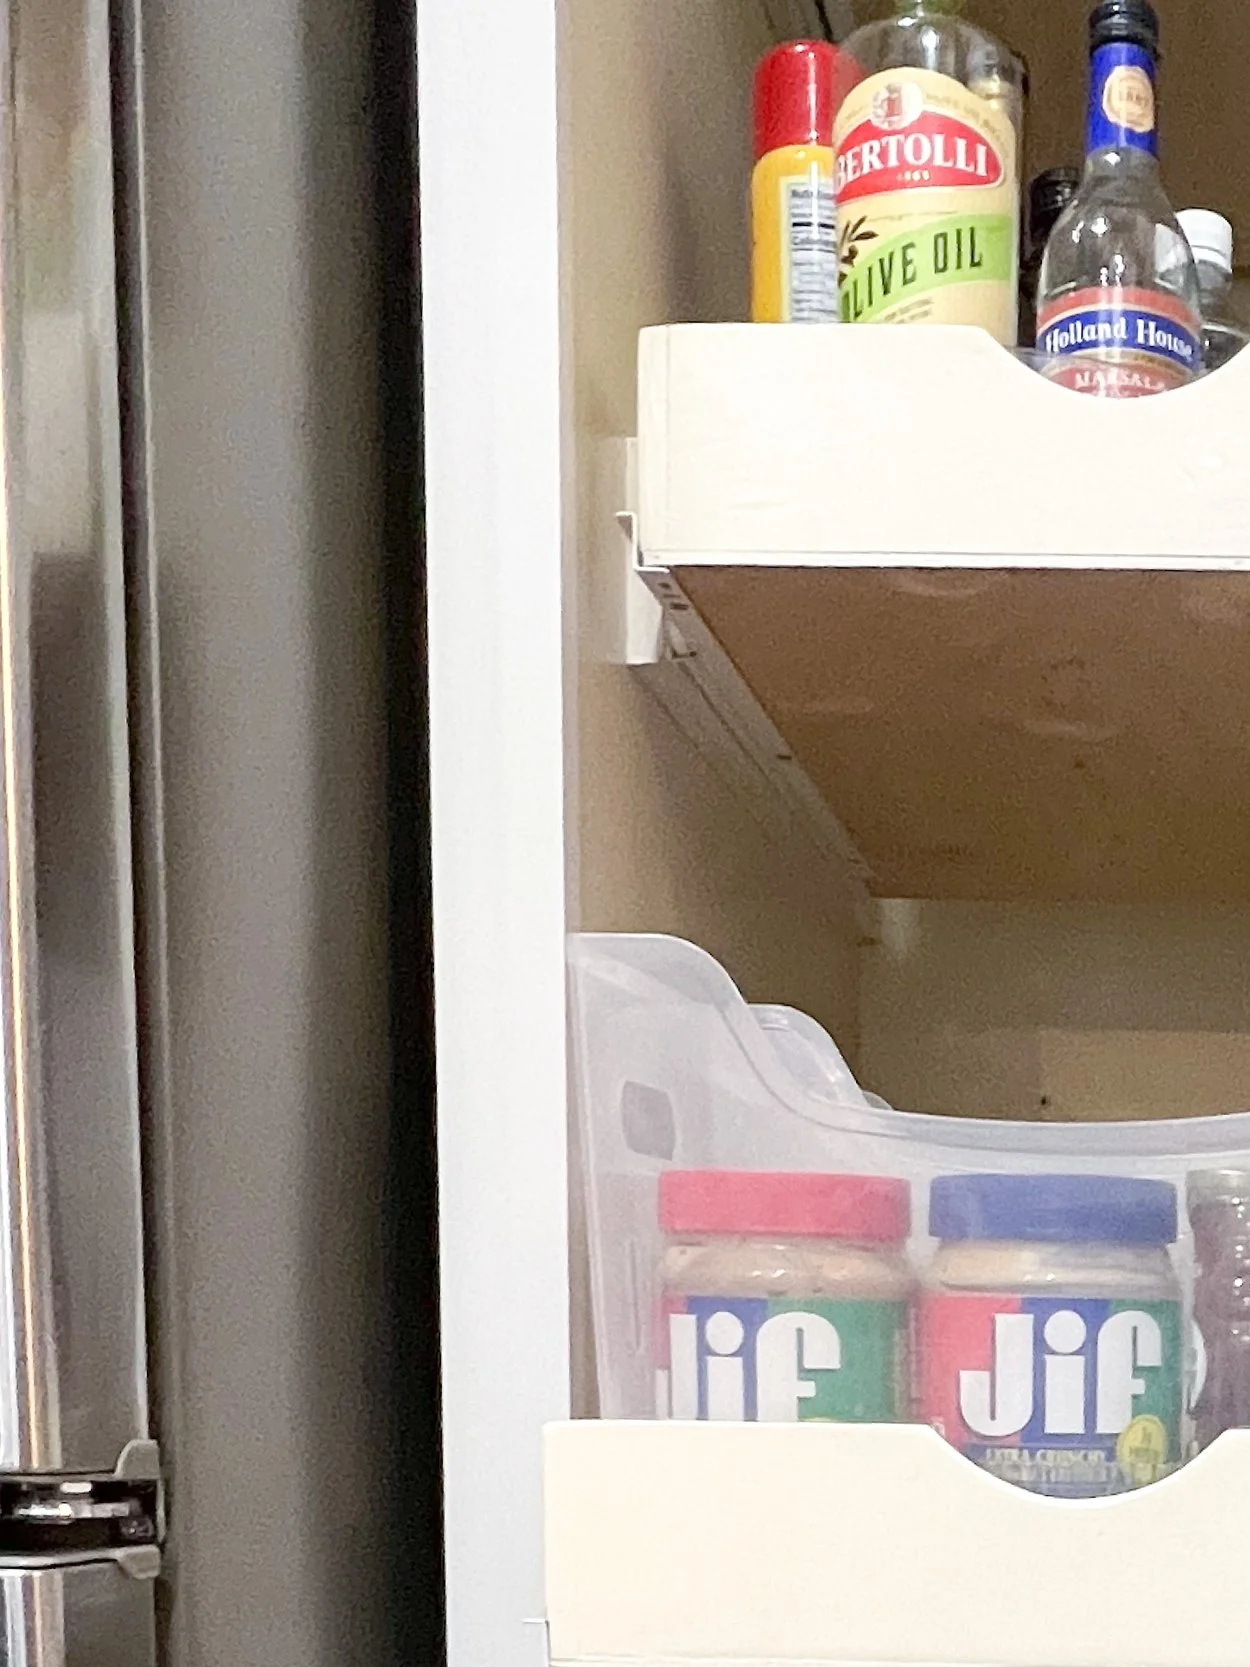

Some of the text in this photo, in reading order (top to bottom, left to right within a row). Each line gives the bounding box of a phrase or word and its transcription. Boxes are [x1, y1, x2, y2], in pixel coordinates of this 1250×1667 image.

[836, 133, 988, 190] BERTOLLI
[934, 226, 982, 274] OIL
[1046, 317, 1195, 361] Holland House
[656, 1311, 842, 1421] Jif
[958, 1309, 1163, 1437] Jif
